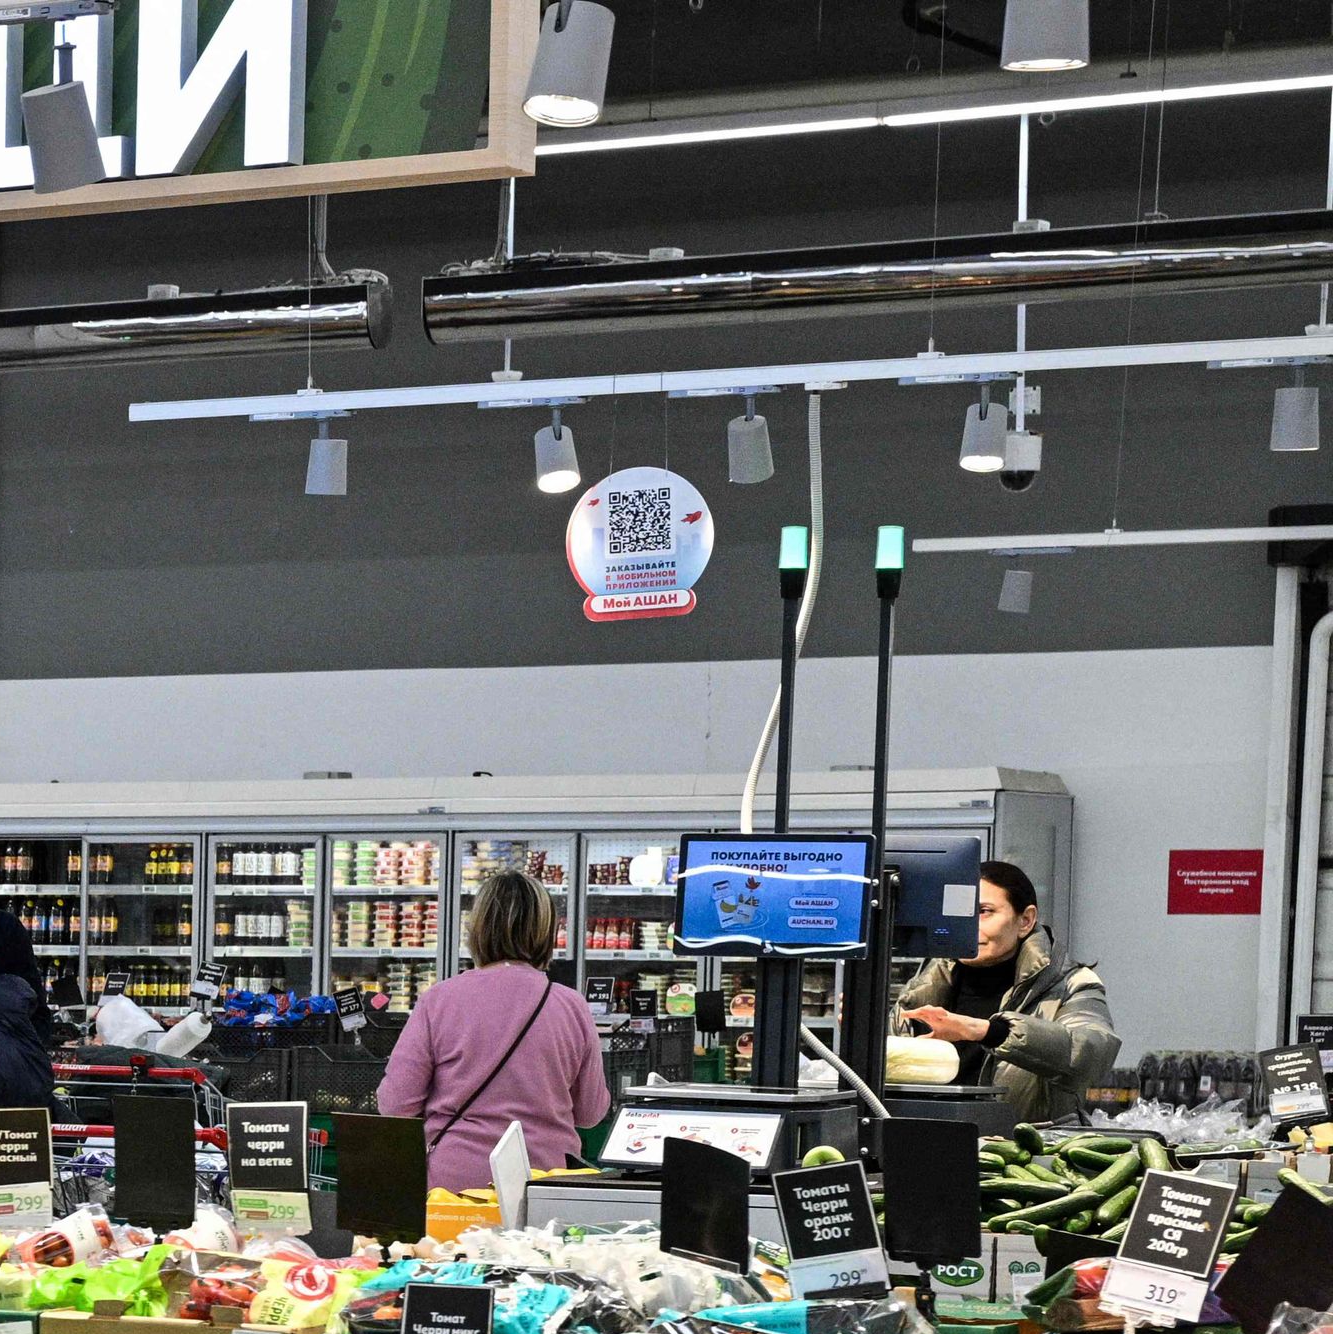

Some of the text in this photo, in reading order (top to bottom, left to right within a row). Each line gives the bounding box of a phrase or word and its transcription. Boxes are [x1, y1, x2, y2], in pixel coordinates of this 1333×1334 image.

[605, 560, 677, 573] ЗАКАЗЫВАЙТЕ
[617, 570, 676, 581] МОБИЛЬНОМ
[605, 579, 677, 590] ПРИЛОЖЕНИИ
[603, 593, 678, 609] Мой АШАН
[711, 850, 843, 863] ПОКУПАЙТЕ ВЫГОДНО
[791, 918, 835, 926] AUCHAN.RU
[241, 1121, 290, 1133] Томаты
[247, 1141, 284, 1153] черри
[241, 1157, 293, 1168] на ветке
[792, 1182, 850, 1200] Томаты
[1160, 1185, 1212, 1206] Томаты
[15, 1196, 44, 1211] 299
[801, 1197, 849, 1214] Черри
[1160, 1200, 1203, 1219] Черри
[270, 1206, 295, 1219] 299
[803, 1211, 854, 1230] оранж
[1146, 1212, 1206, 1234] красные
[812, 1227, 843, 1242] 200
[1162, 1228, 1183, 1242] СЯ
[936, 1264, 979, 1278] РОСТ
[829, 1269, 862, 1288] 299
[1144, 1283, 1178, 1304] 319
[430, 1311, 466, 1324] Томат
